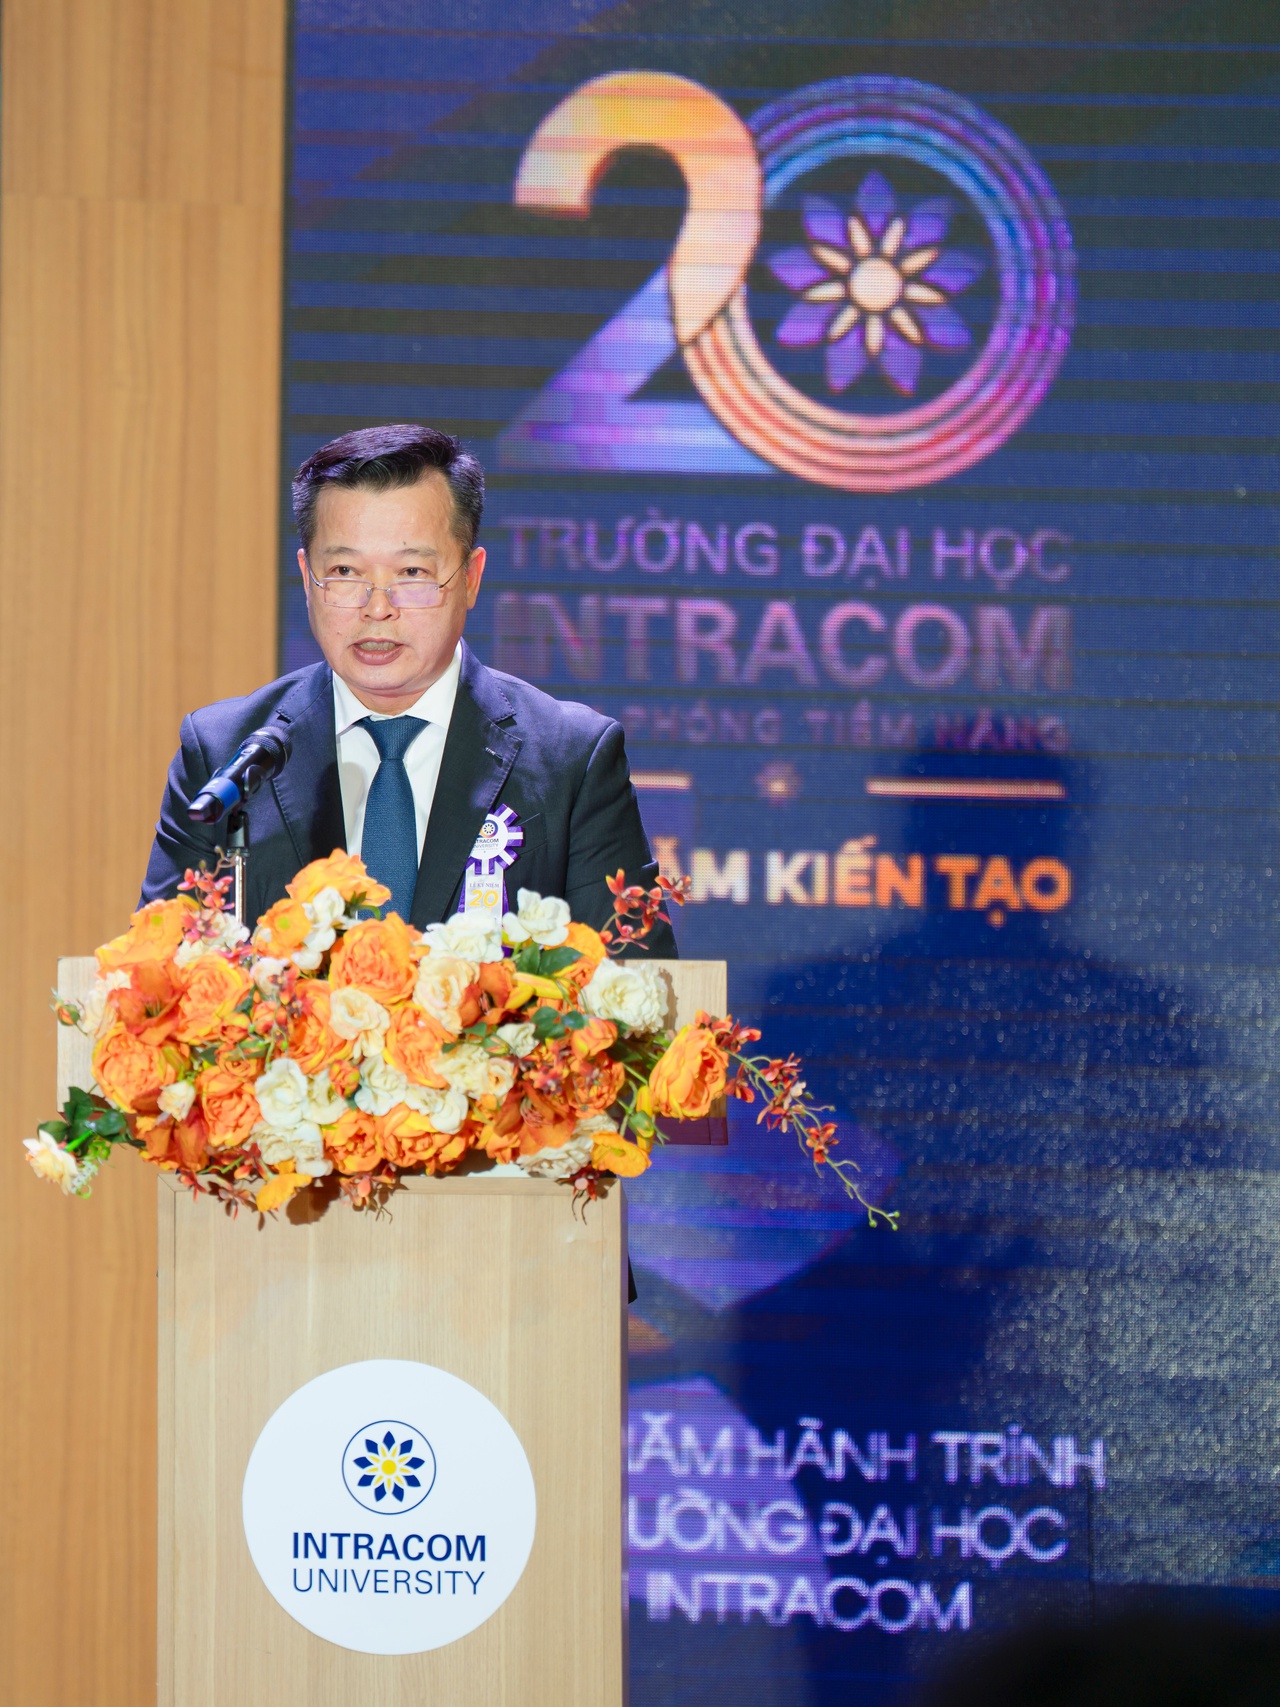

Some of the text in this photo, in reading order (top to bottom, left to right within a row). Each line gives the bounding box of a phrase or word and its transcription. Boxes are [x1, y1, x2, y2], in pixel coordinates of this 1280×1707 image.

[497, 508, 1072, 592] TRƯỜNG ĐẠI HỌC
[493, 591, 1075, 691] INTRACOM
[469, 889, 499, 907] 20
[765, 835, 923, 908] KIẾN
[933, 854, 1072, 929] TẠO
[628, 1412, 734, 1478] ĂM
[292, 1532, 487, 1562] INTRACOM
[819, 1501, 918, 1567] ĐẠI
[931, 1504, 1069, 1569] HỌC
[292, 1567, 486, 1596] UNIVERSITY
[646, 1571, 974, 1633] INTRACOM
